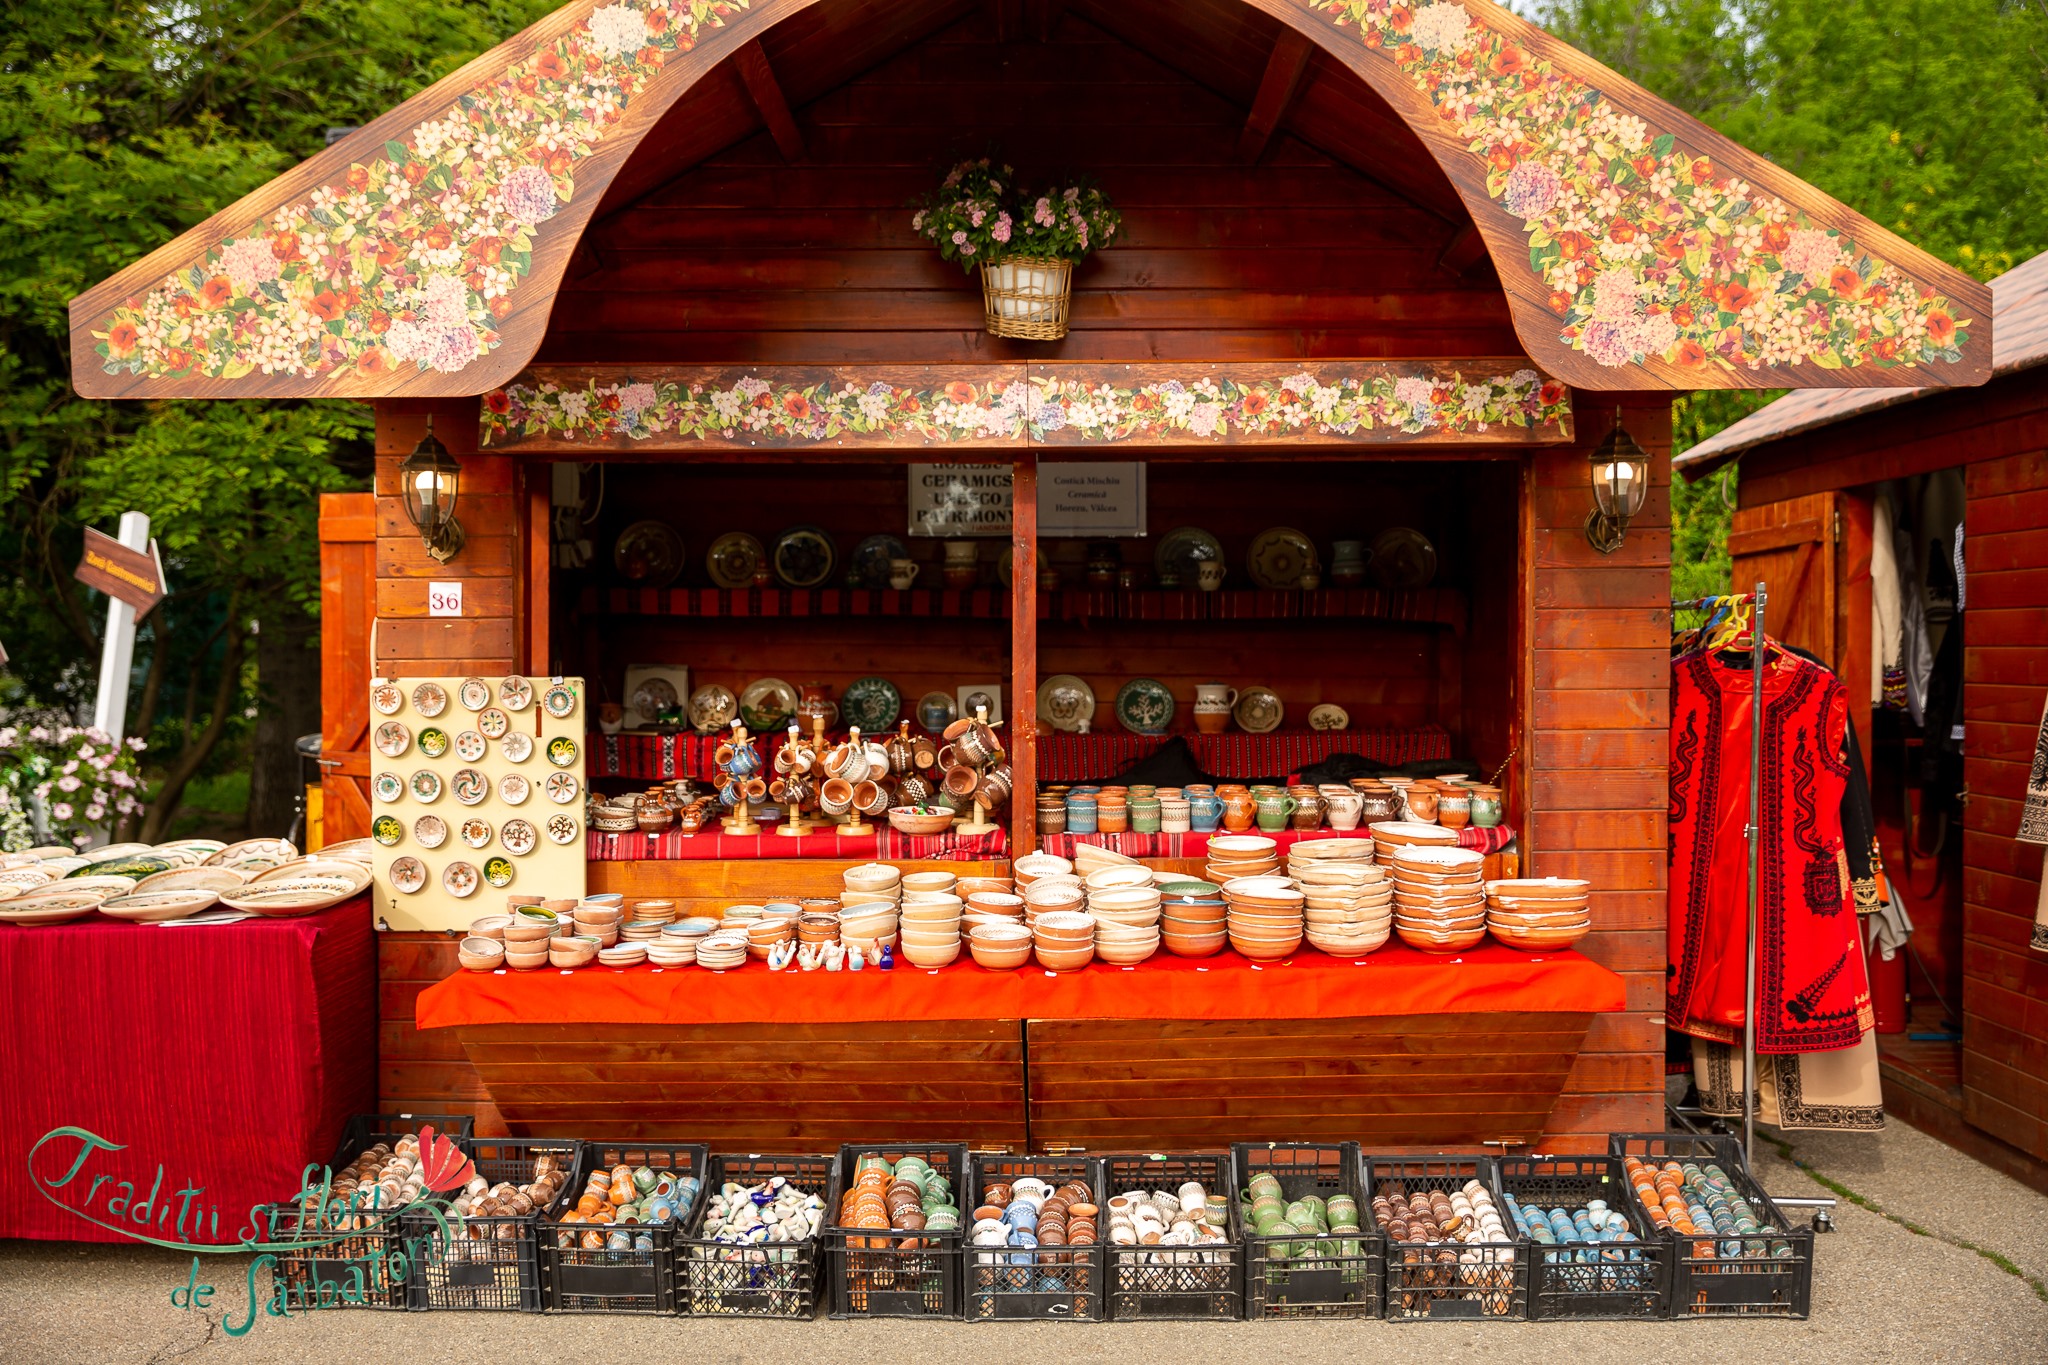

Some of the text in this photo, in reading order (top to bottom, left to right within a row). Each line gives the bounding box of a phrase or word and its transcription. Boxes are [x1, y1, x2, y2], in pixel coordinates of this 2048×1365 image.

[922, 474, 1013, 487] CERAMICS
[916, 509, 1013, 523] PARIMON
[432, 592, 458, 610] 36
